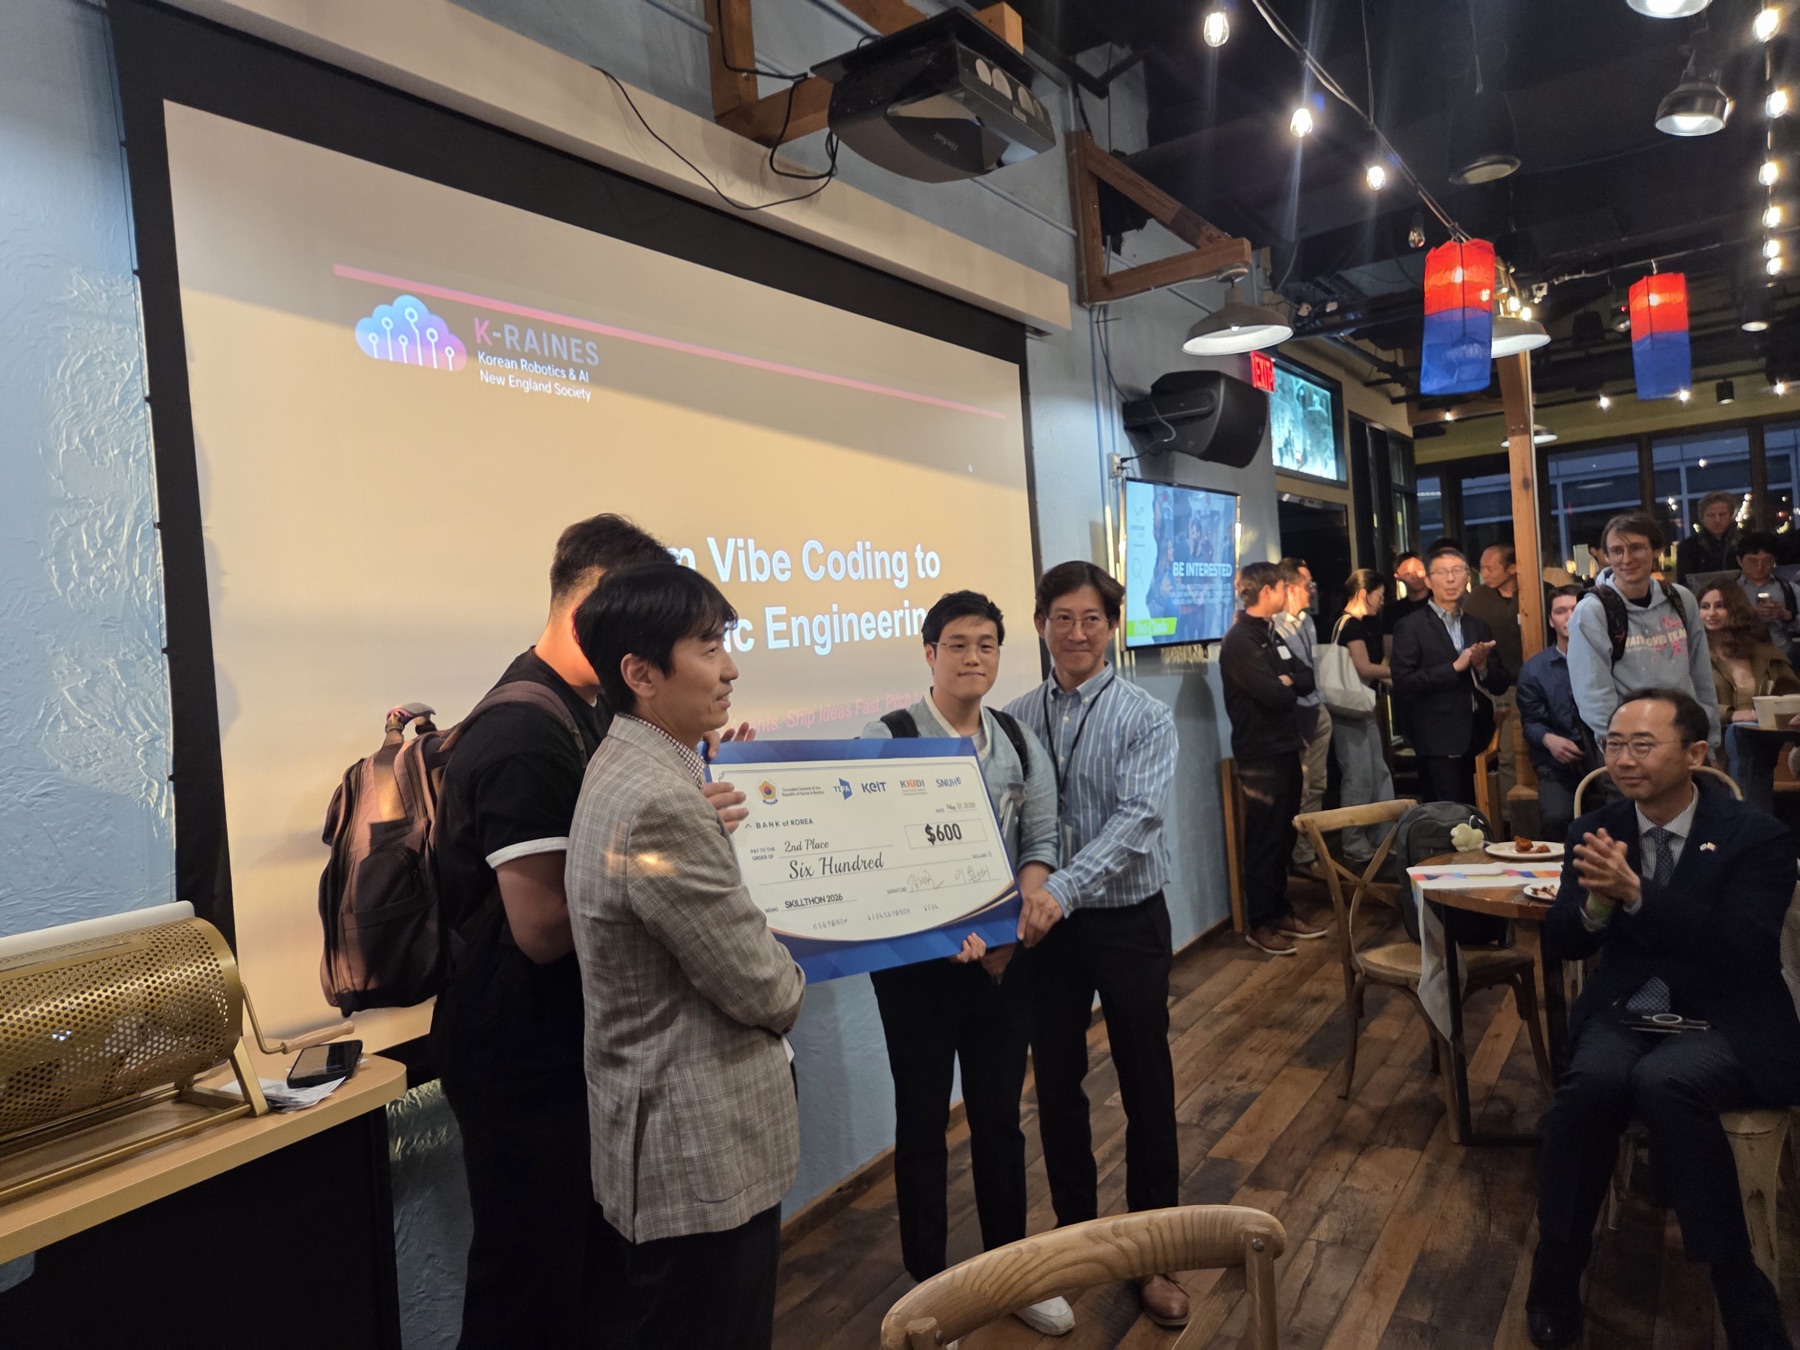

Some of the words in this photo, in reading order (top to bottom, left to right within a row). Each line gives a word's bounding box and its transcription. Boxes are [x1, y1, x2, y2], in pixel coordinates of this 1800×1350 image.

[474, 317, 600, 367] K-RAINES
[477, 350, 518, 370] Korean
[520, 358, 567, 379] Robotics
[568, 367, 577, 381] &
[578, 369, 590, 383] AI
[480, 369, 506, 386] New
[508, 374, 552, 393] England
[554, 382, 591, 403] Society
[706, 536, 792, 583] Vibe
[802, 539, 909, 589] Coding
[914, 543, 941, 579] to
[1173, 561, 1184, 576] BE
[1186, 561, 1233, 577] INTERESTED
[765, 600, 927, 656] Engineerin
[786, 709, 816, 729] Ship
[819, 703, 852, 722] Ideas
[755, 820, 780, 829] BANK
[782, 819, 789, 827] of
[790, 818, 814, 826] KOREA
[925, 823, 962, 845] $600
[784, 840, 803, 853] 2nd
[805, 838, 830, 850] Place
[789, 859, 815, 880] Six
[818, 852, 885, 875] Hundred
[784, 895, 826, 909] SKILLTHON
[826, 893, 843, 903] 2026
